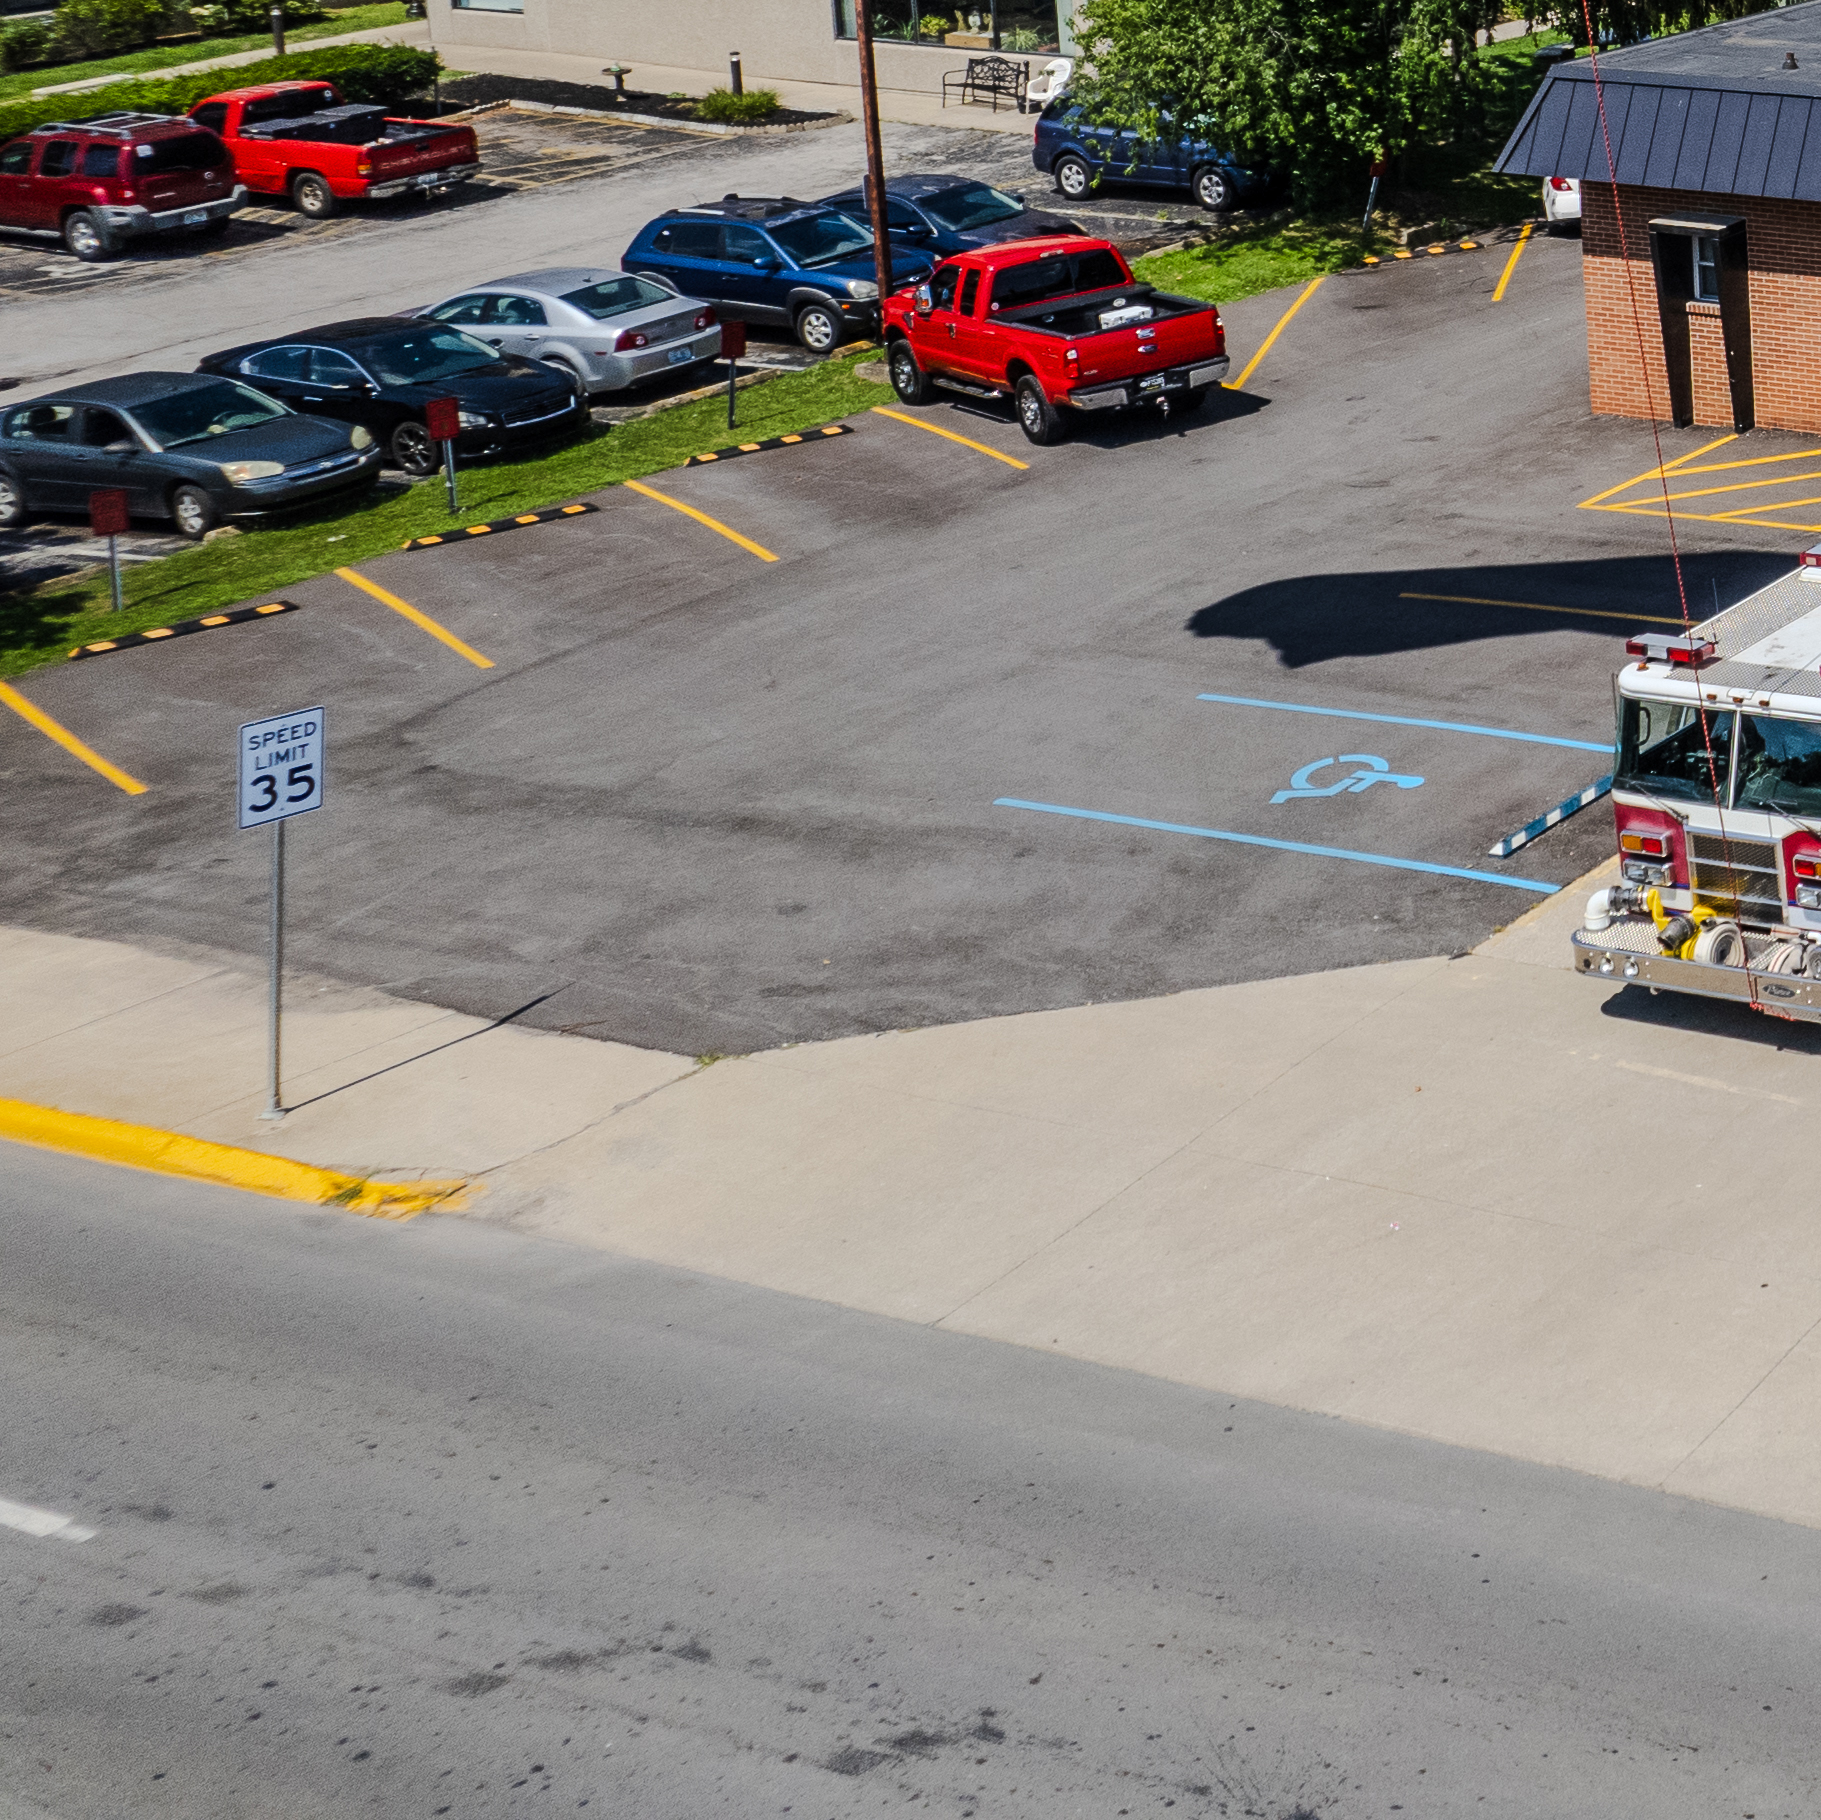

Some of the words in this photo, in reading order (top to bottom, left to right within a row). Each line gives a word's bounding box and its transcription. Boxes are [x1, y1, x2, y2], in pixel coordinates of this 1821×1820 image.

[248, 721, 317, 751] SPEED
[255, 743, 310, 771] LIMIT
[248, 762, 316, 813] 35
